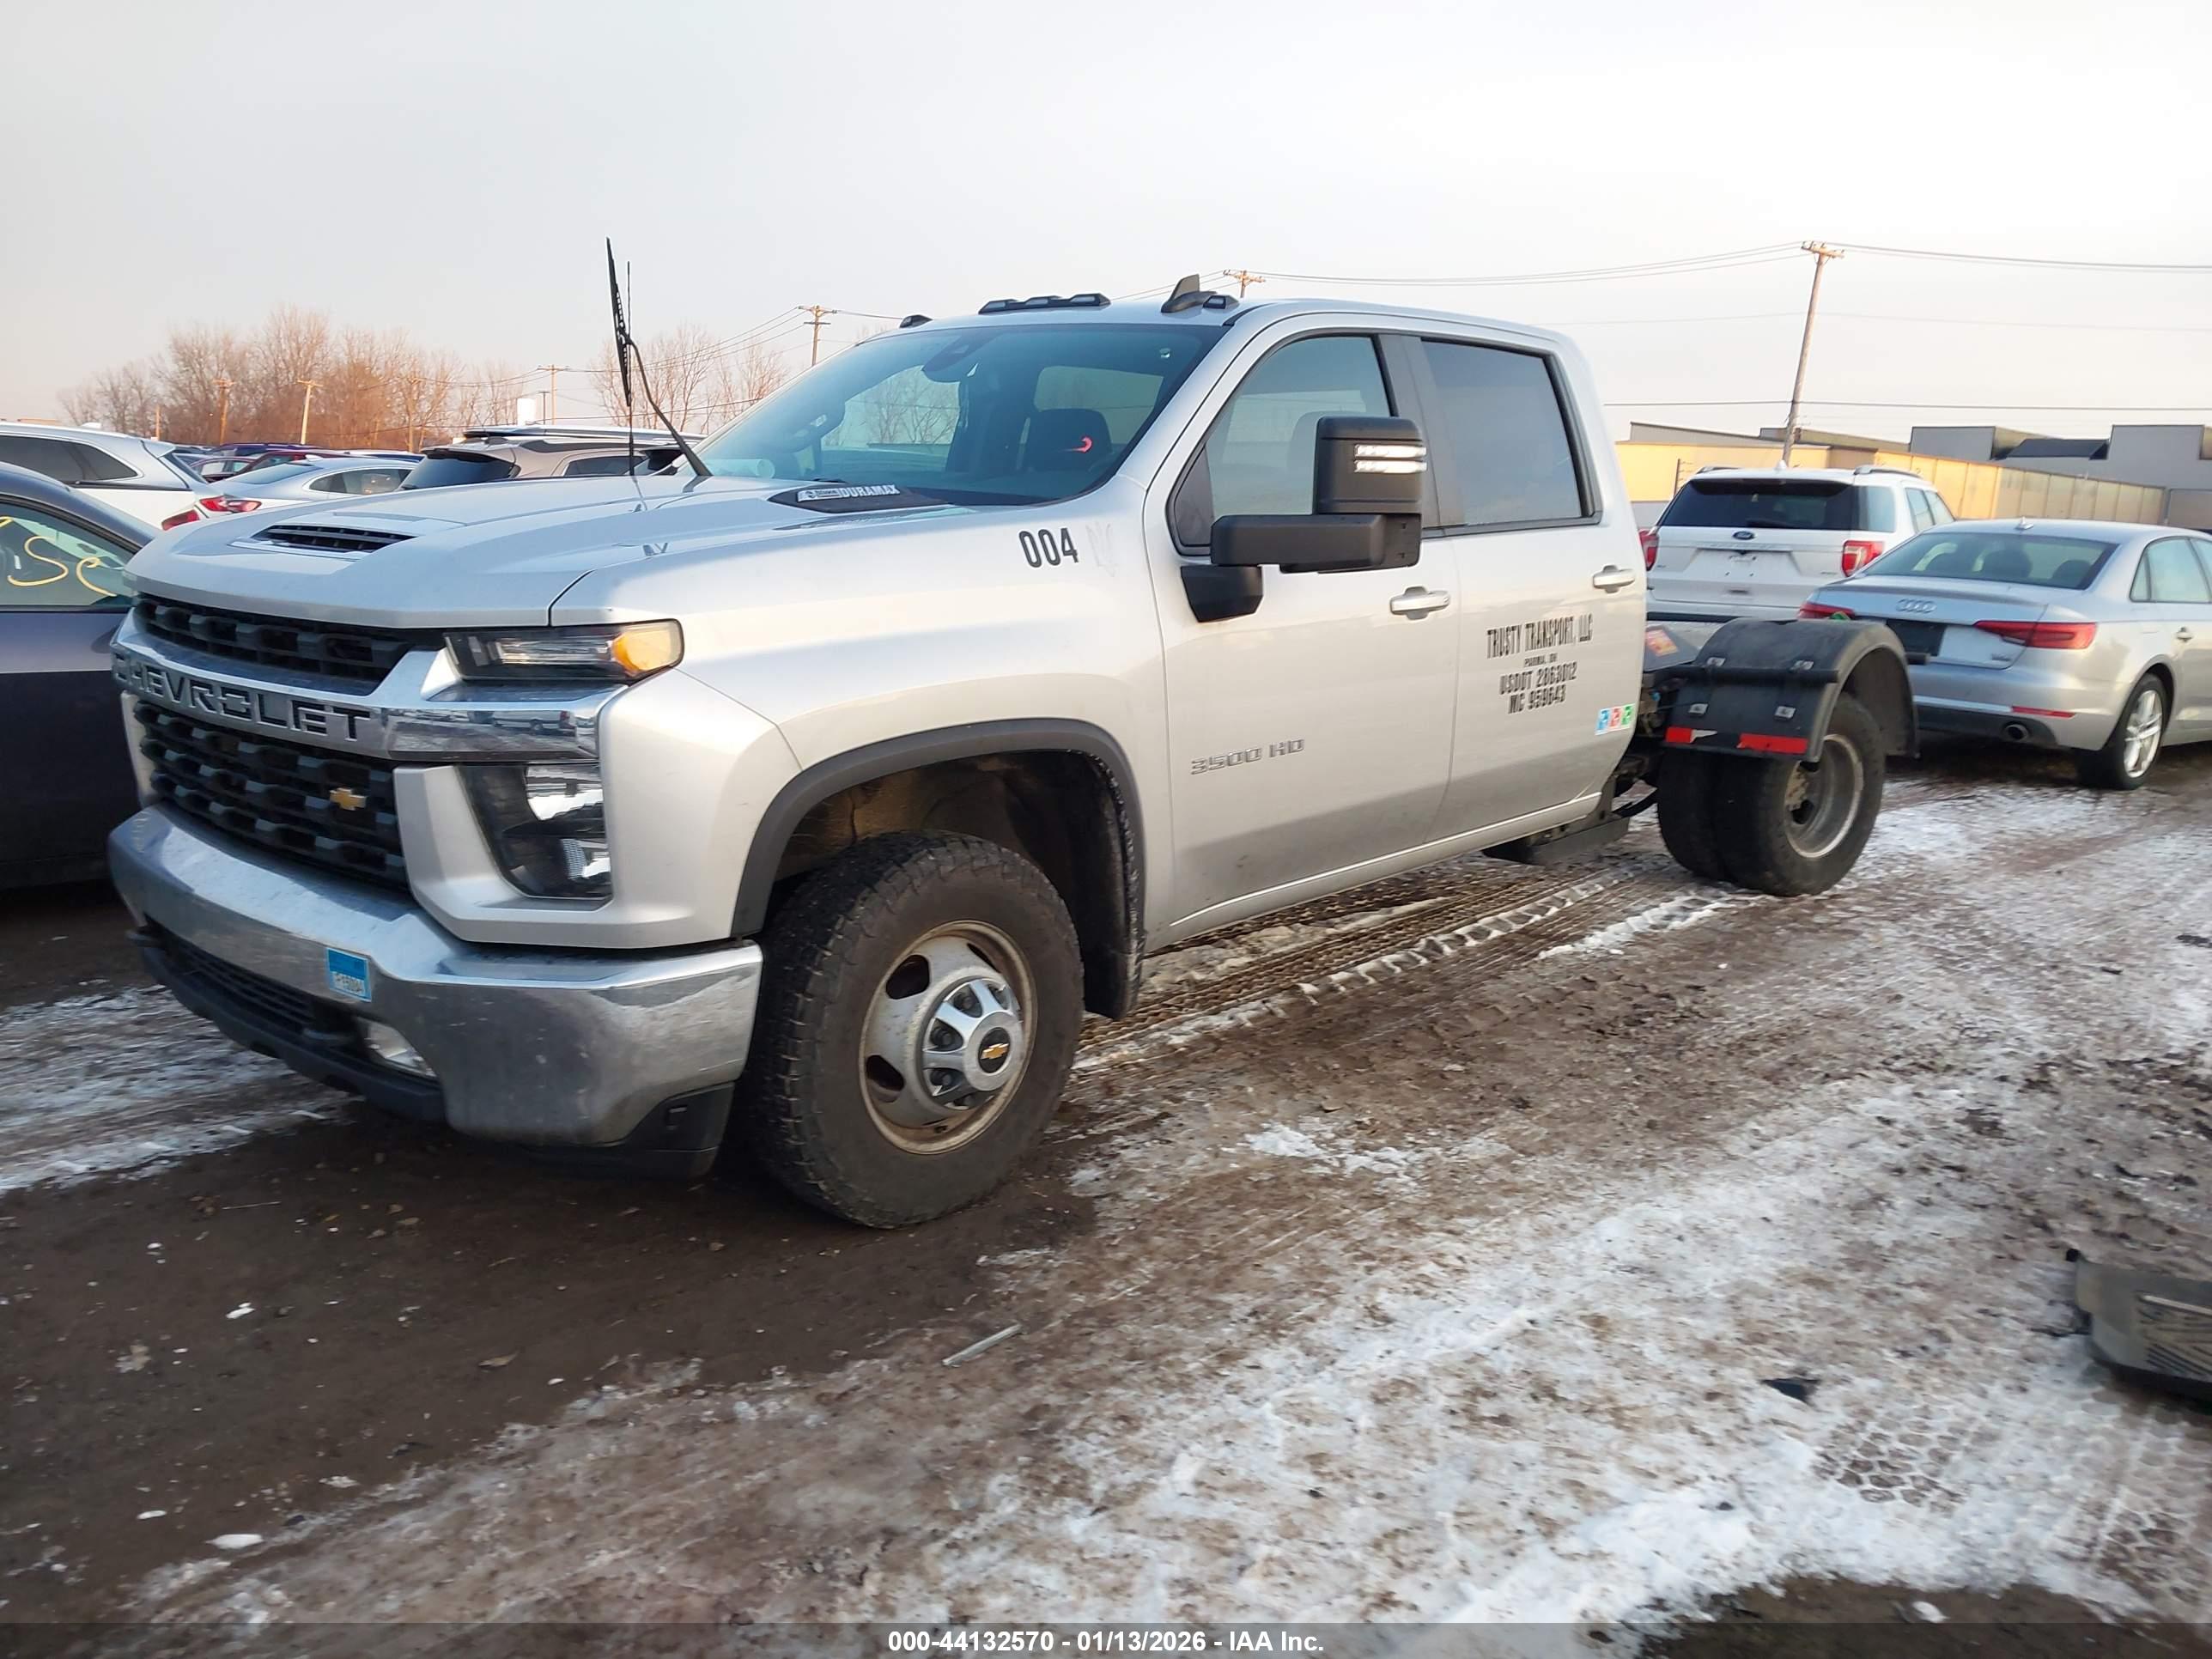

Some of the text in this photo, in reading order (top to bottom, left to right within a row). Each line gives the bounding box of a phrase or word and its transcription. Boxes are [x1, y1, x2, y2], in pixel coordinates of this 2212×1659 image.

[841, 484, 901, 498] DURAMAX
[1018, 527, 1079, 568] 004
[1486, 613, 1593, 659] TRUSTY TRANSPORT, LLC
[111, 649, 372, 742] CHEVROLET
[1499, 661, 1577, 696] USDOT 2863012
[1508, 684, 1566, 714] MC 959643
[1190, 738, 1304, 775] 3500 HD
